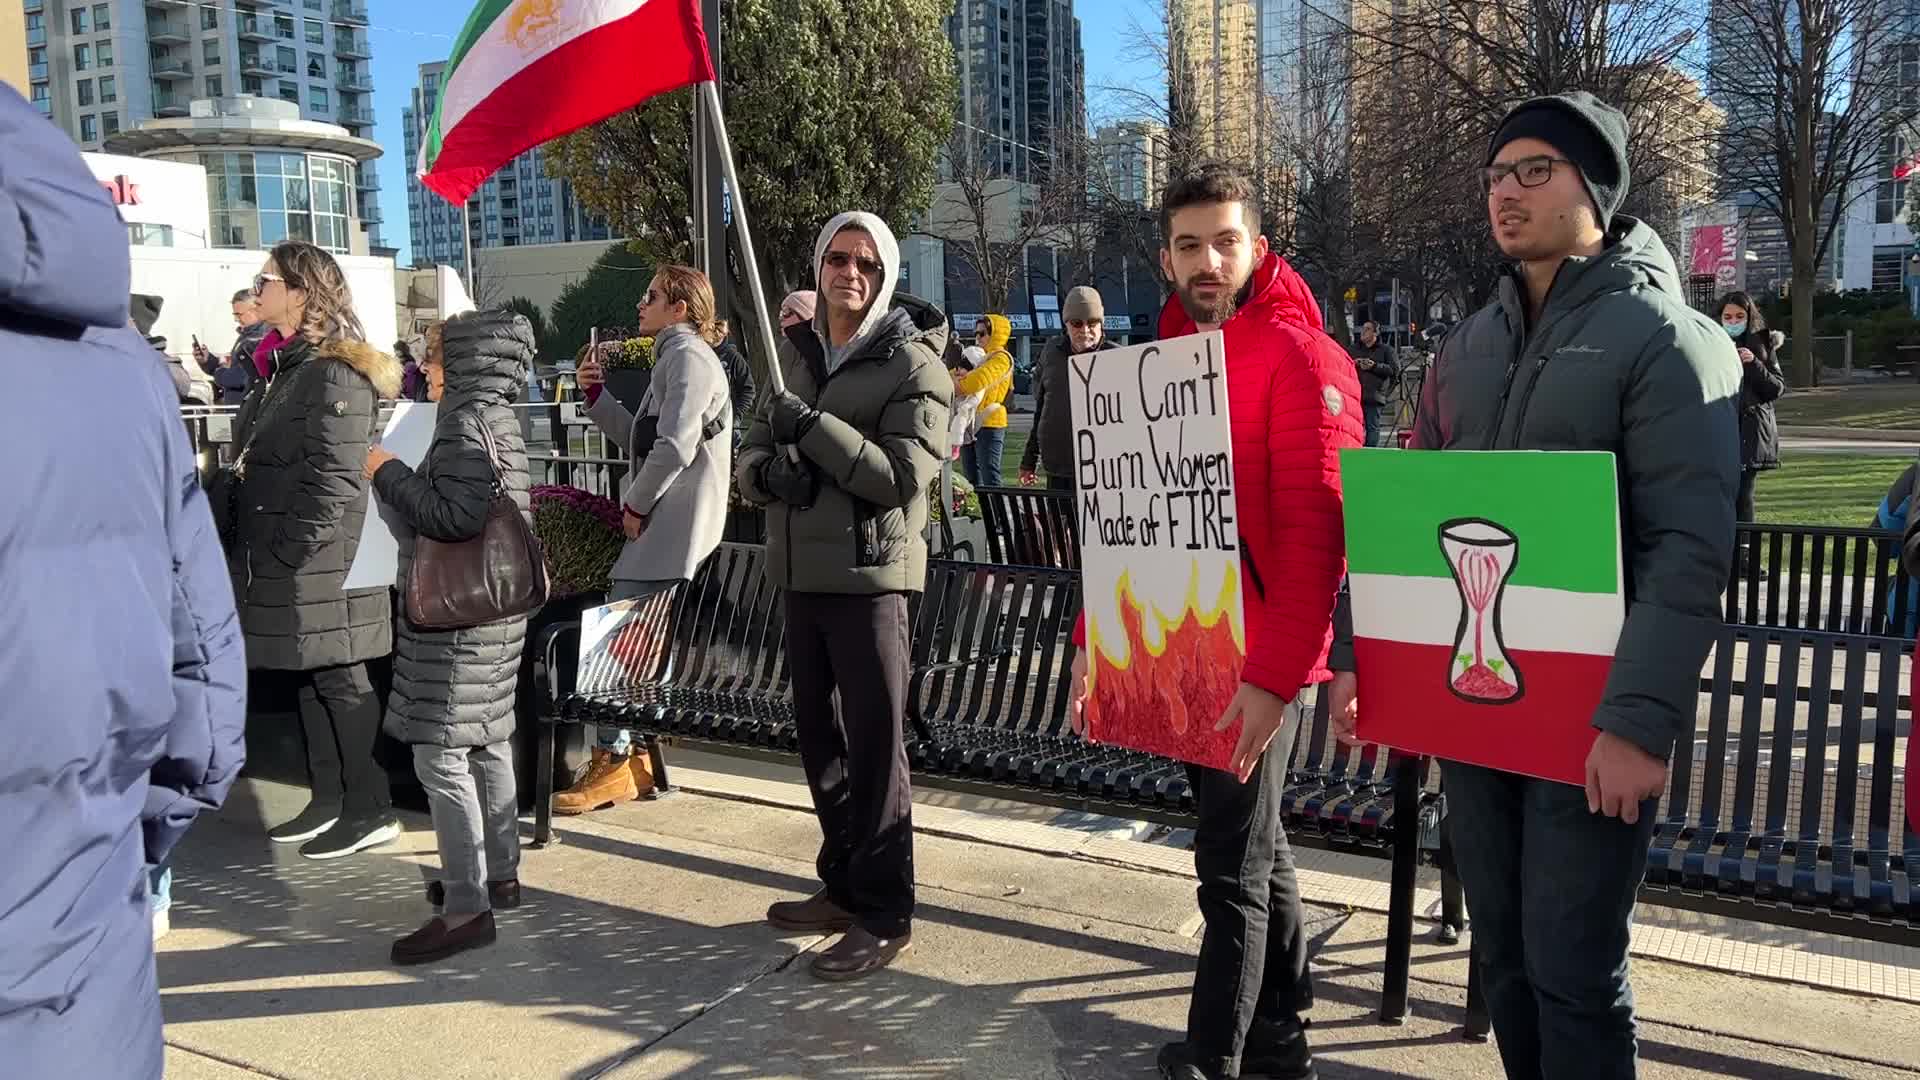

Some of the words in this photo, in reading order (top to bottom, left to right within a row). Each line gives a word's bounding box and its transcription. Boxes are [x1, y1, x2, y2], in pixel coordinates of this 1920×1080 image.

[1071, 354, 1124, 426] You
[1138, 338, 1219, 422] Can't
[1077, 429, 1148, 490] Burn
[1147, 420, 1230, 490] Women
[1082, 490, 1137, 547] Made
[1139, 493, 1161, 547] of
[1166, 488, 1236, 551] FIRE
